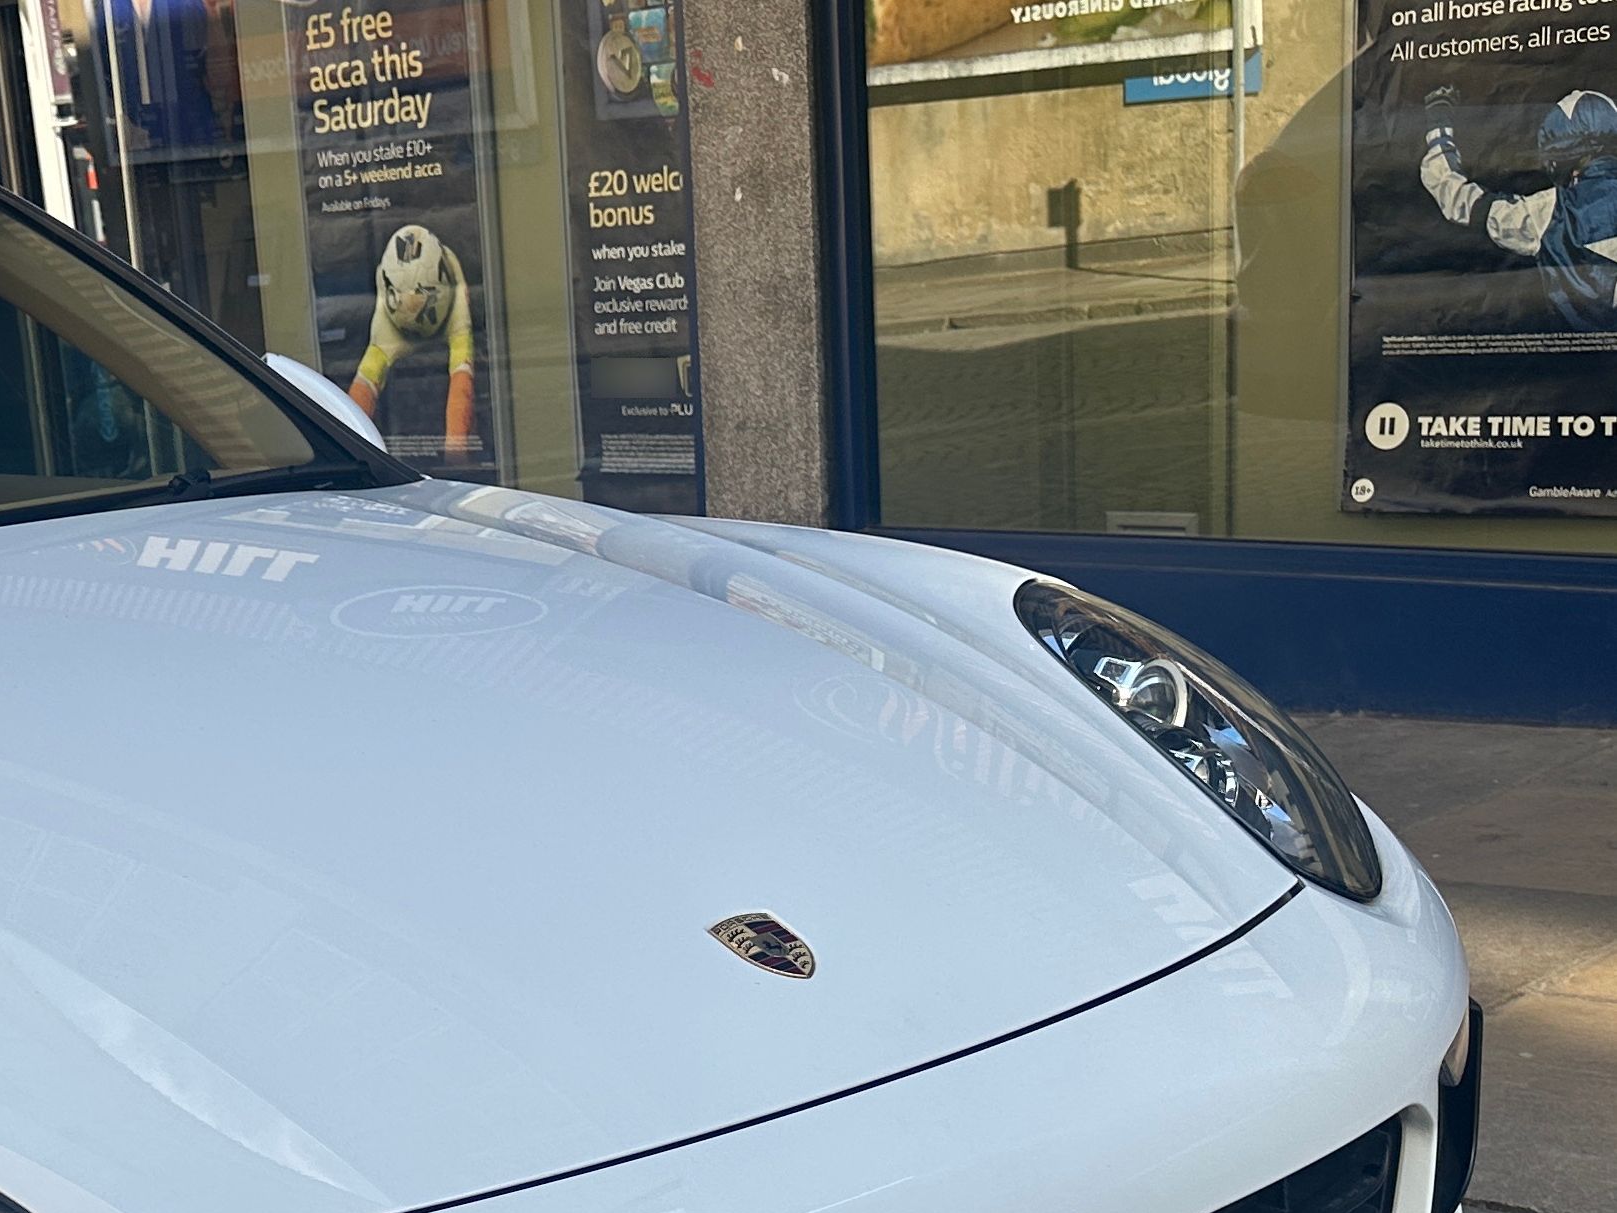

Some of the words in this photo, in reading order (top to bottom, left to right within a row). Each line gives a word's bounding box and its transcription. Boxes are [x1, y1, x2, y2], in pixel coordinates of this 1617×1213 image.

[1391, 10, 1416, 26] on
[1421, 2, 1444, 23] all
[1448, 0, 1505, 20] horse
[306, 13, 335, 50] £5
[340, 7, 392, 44] free
[1390, 41, 1414, 62] All
[1418, 34, 1524, 60] customers,
[1528, 26, 1551, 48] all
[1556, 24, 1611, 45] races
[309, 59, 367, 93] acca
[371, 42, 423, 82] this
[313, 87, 432, 133] Saturday
[317, 150, 350, 168] When
[351, 149, 372, 167] you
[373, 142, 404, 161] stake
[406, 140, 433, 158] £10+
[318, 174, 333, 188] on
[335, 174, 343, 187] a
[343, 169, 358, 186] 5+
[360, 162, 412, 184] weekend
[414, 162, 442, 178] acca
[588, 169, 628, 197] £20
[632, 165, 683, 194] welc
[589, 202, 654, 228] bonus
[591, 244, 626, 260] when
[626, 245, 649, 262] you
[651, 240, 686, 257] stake
[593, 276, 616, 292] Join
[617, 275, 654, 293] Vegas
[655, 272, 685, 289] Club
[593, 296, 643, 313] exclusive
[594, 319, 617, 335] and
[619, 318, 642, 334] free
[644, 317, 678, 334] credit
[621, 405, 658, 416] Exclusive
[659, 406, 669, 416] to
[1417, 416, 1481, 437] TAKE
[1488, 416, 1551, 437] TIME
[1558, 416, 1595, 437] TO
[1421, 439, 1524, 449] taketimetothink.co.uk
[1529, 485, 1602, 498] GambleAware
